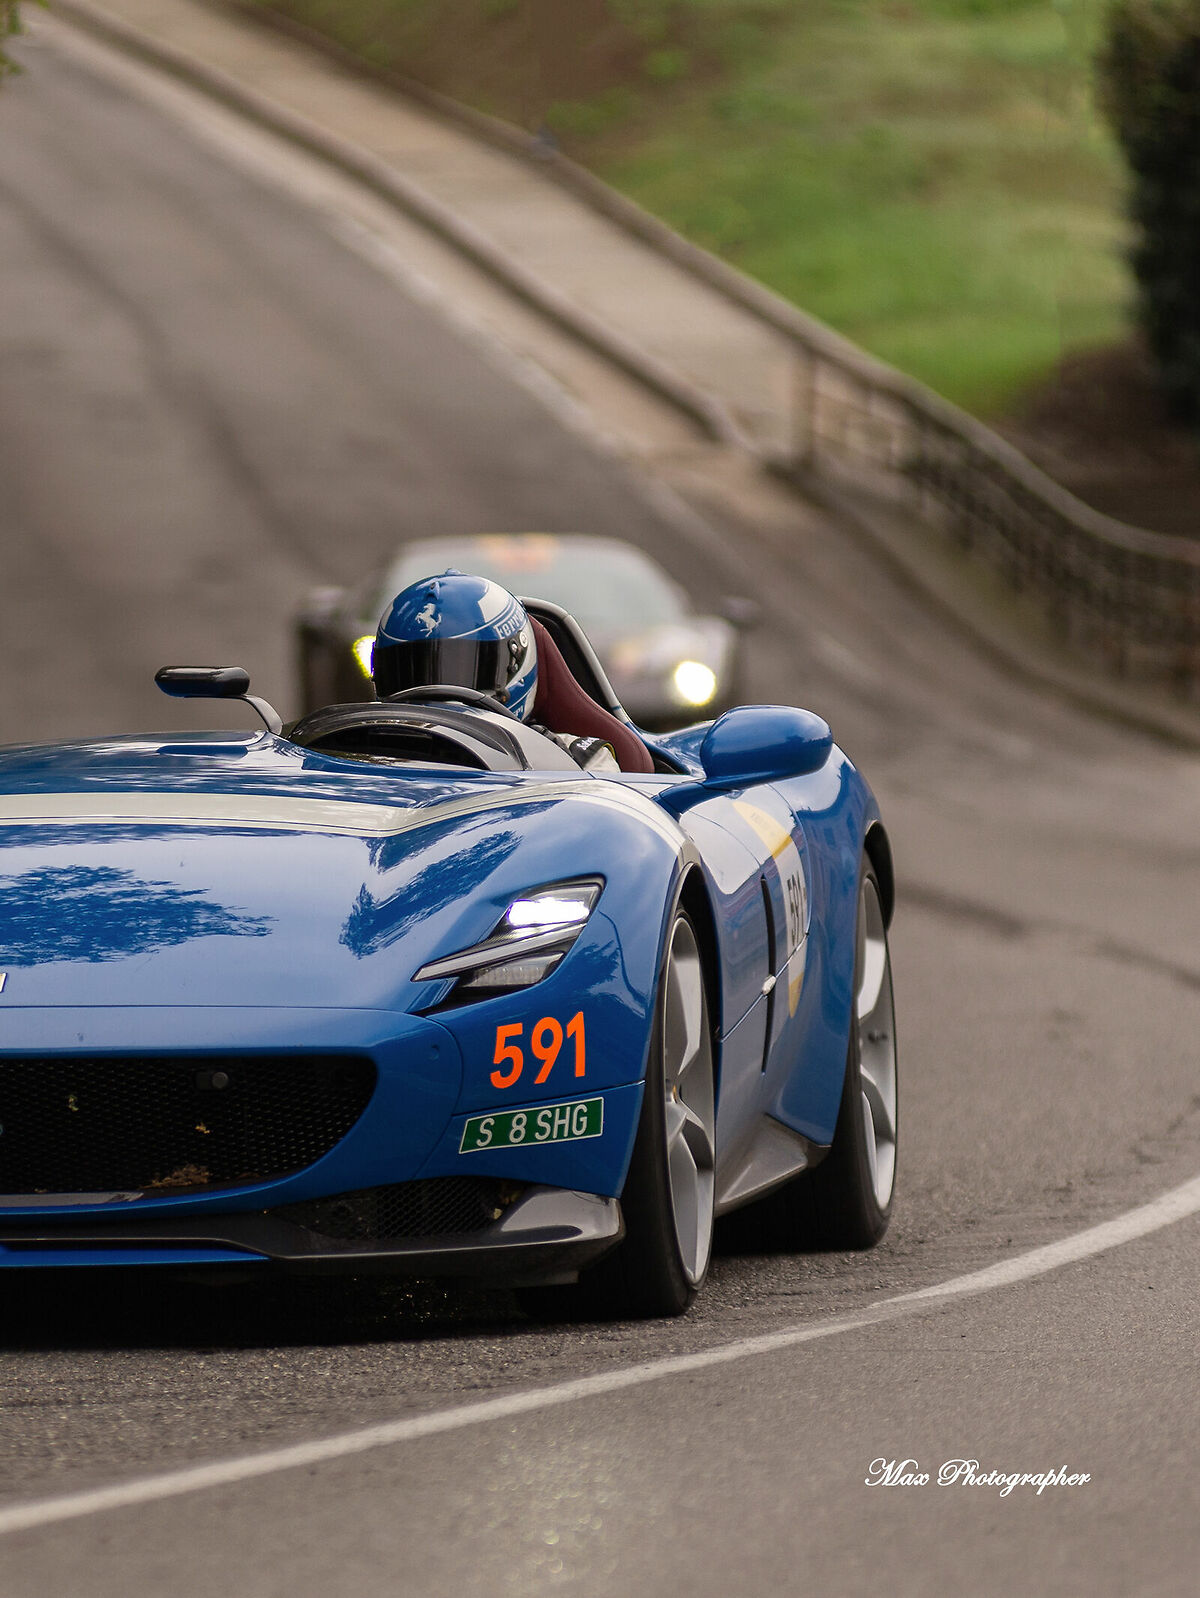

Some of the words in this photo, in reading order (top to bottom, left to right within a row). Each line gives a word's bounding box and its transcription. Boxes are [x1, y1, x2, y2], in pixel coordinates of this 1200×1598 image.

[490, 1011, 586, 1089] 591
[476, 1117, 495, 1147] S
[509, 1113, 527, 1143] 8
[534, 1104, 588, 1141] SHG
